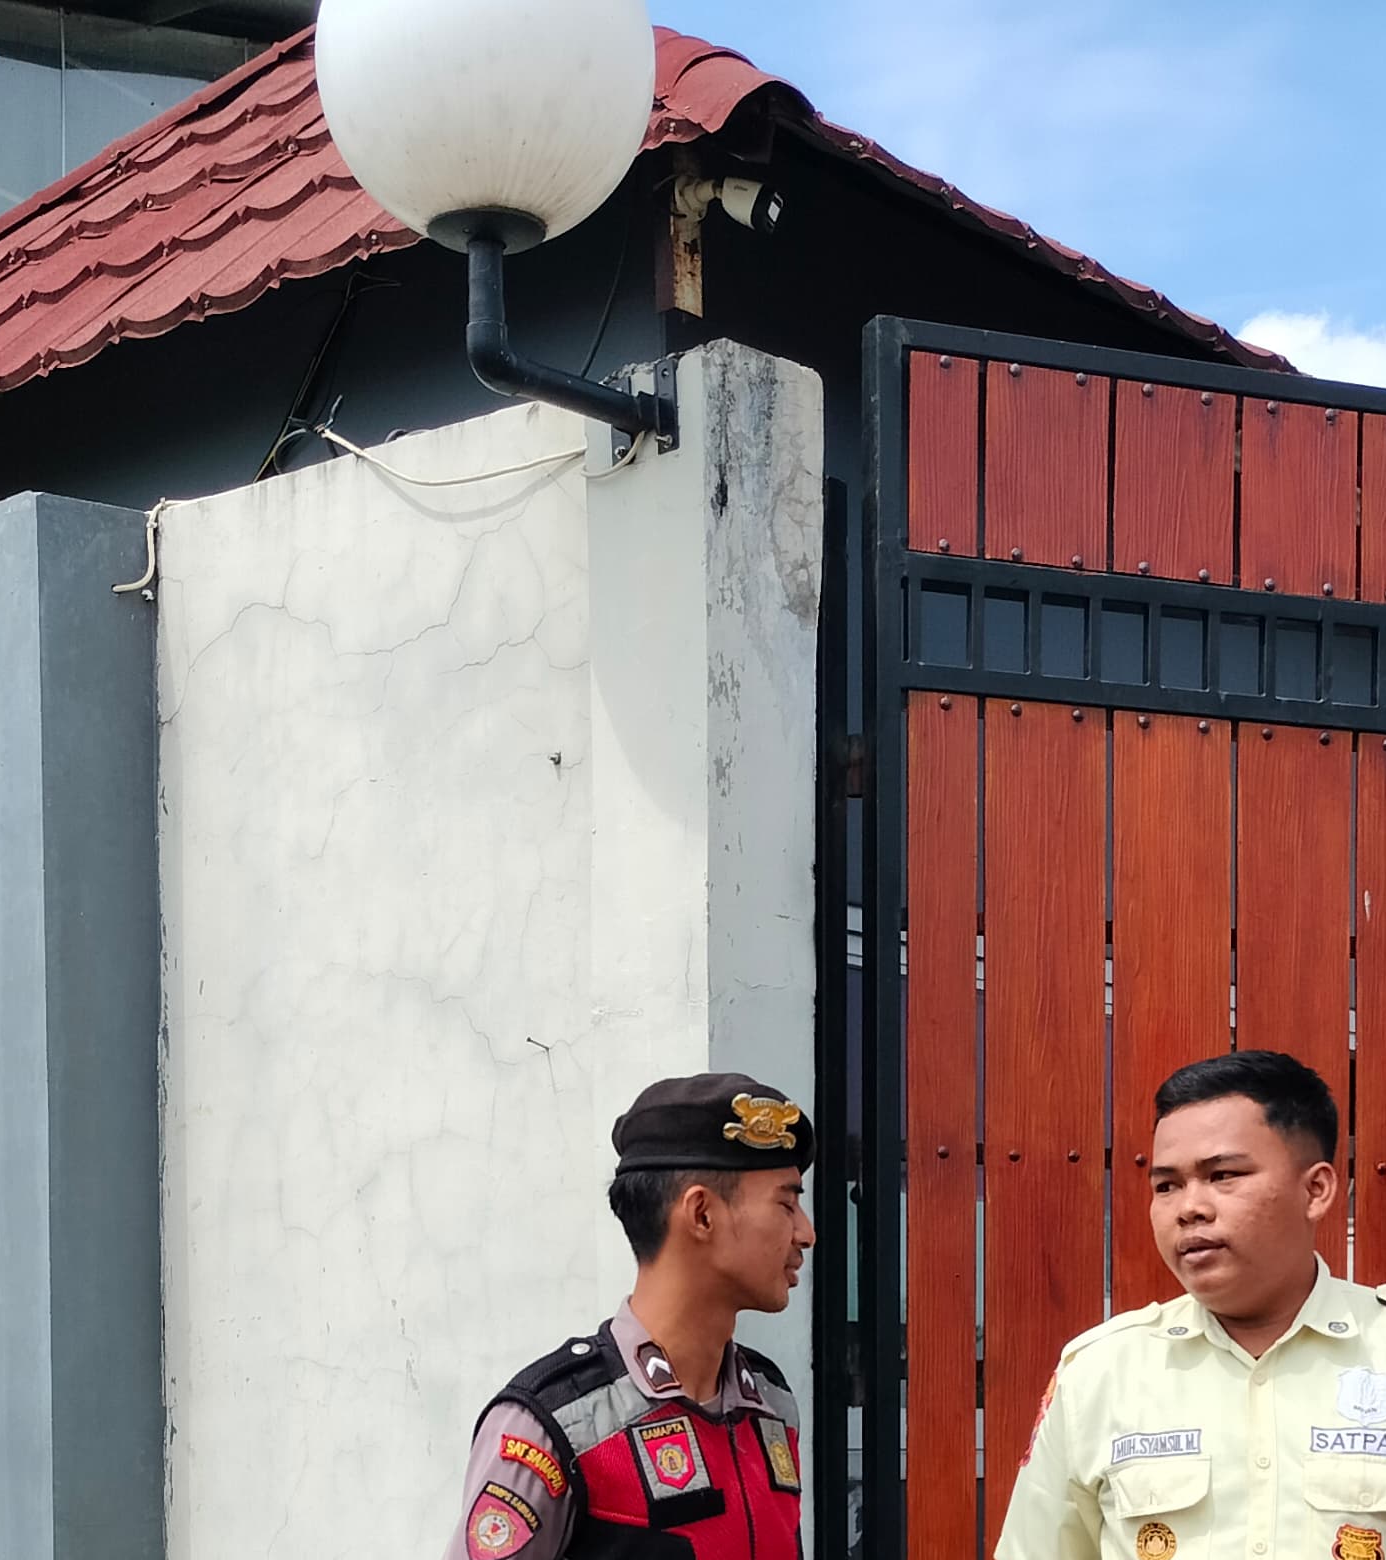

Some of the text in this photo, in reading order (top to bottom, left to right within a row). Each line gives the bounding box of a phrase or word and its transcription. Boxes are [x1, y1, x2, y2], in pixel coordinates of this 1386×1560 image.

[640, 1422, 685, 1441] SAMAPTA
[505, 1439, 564, 1491] SAT SAMAPTA
